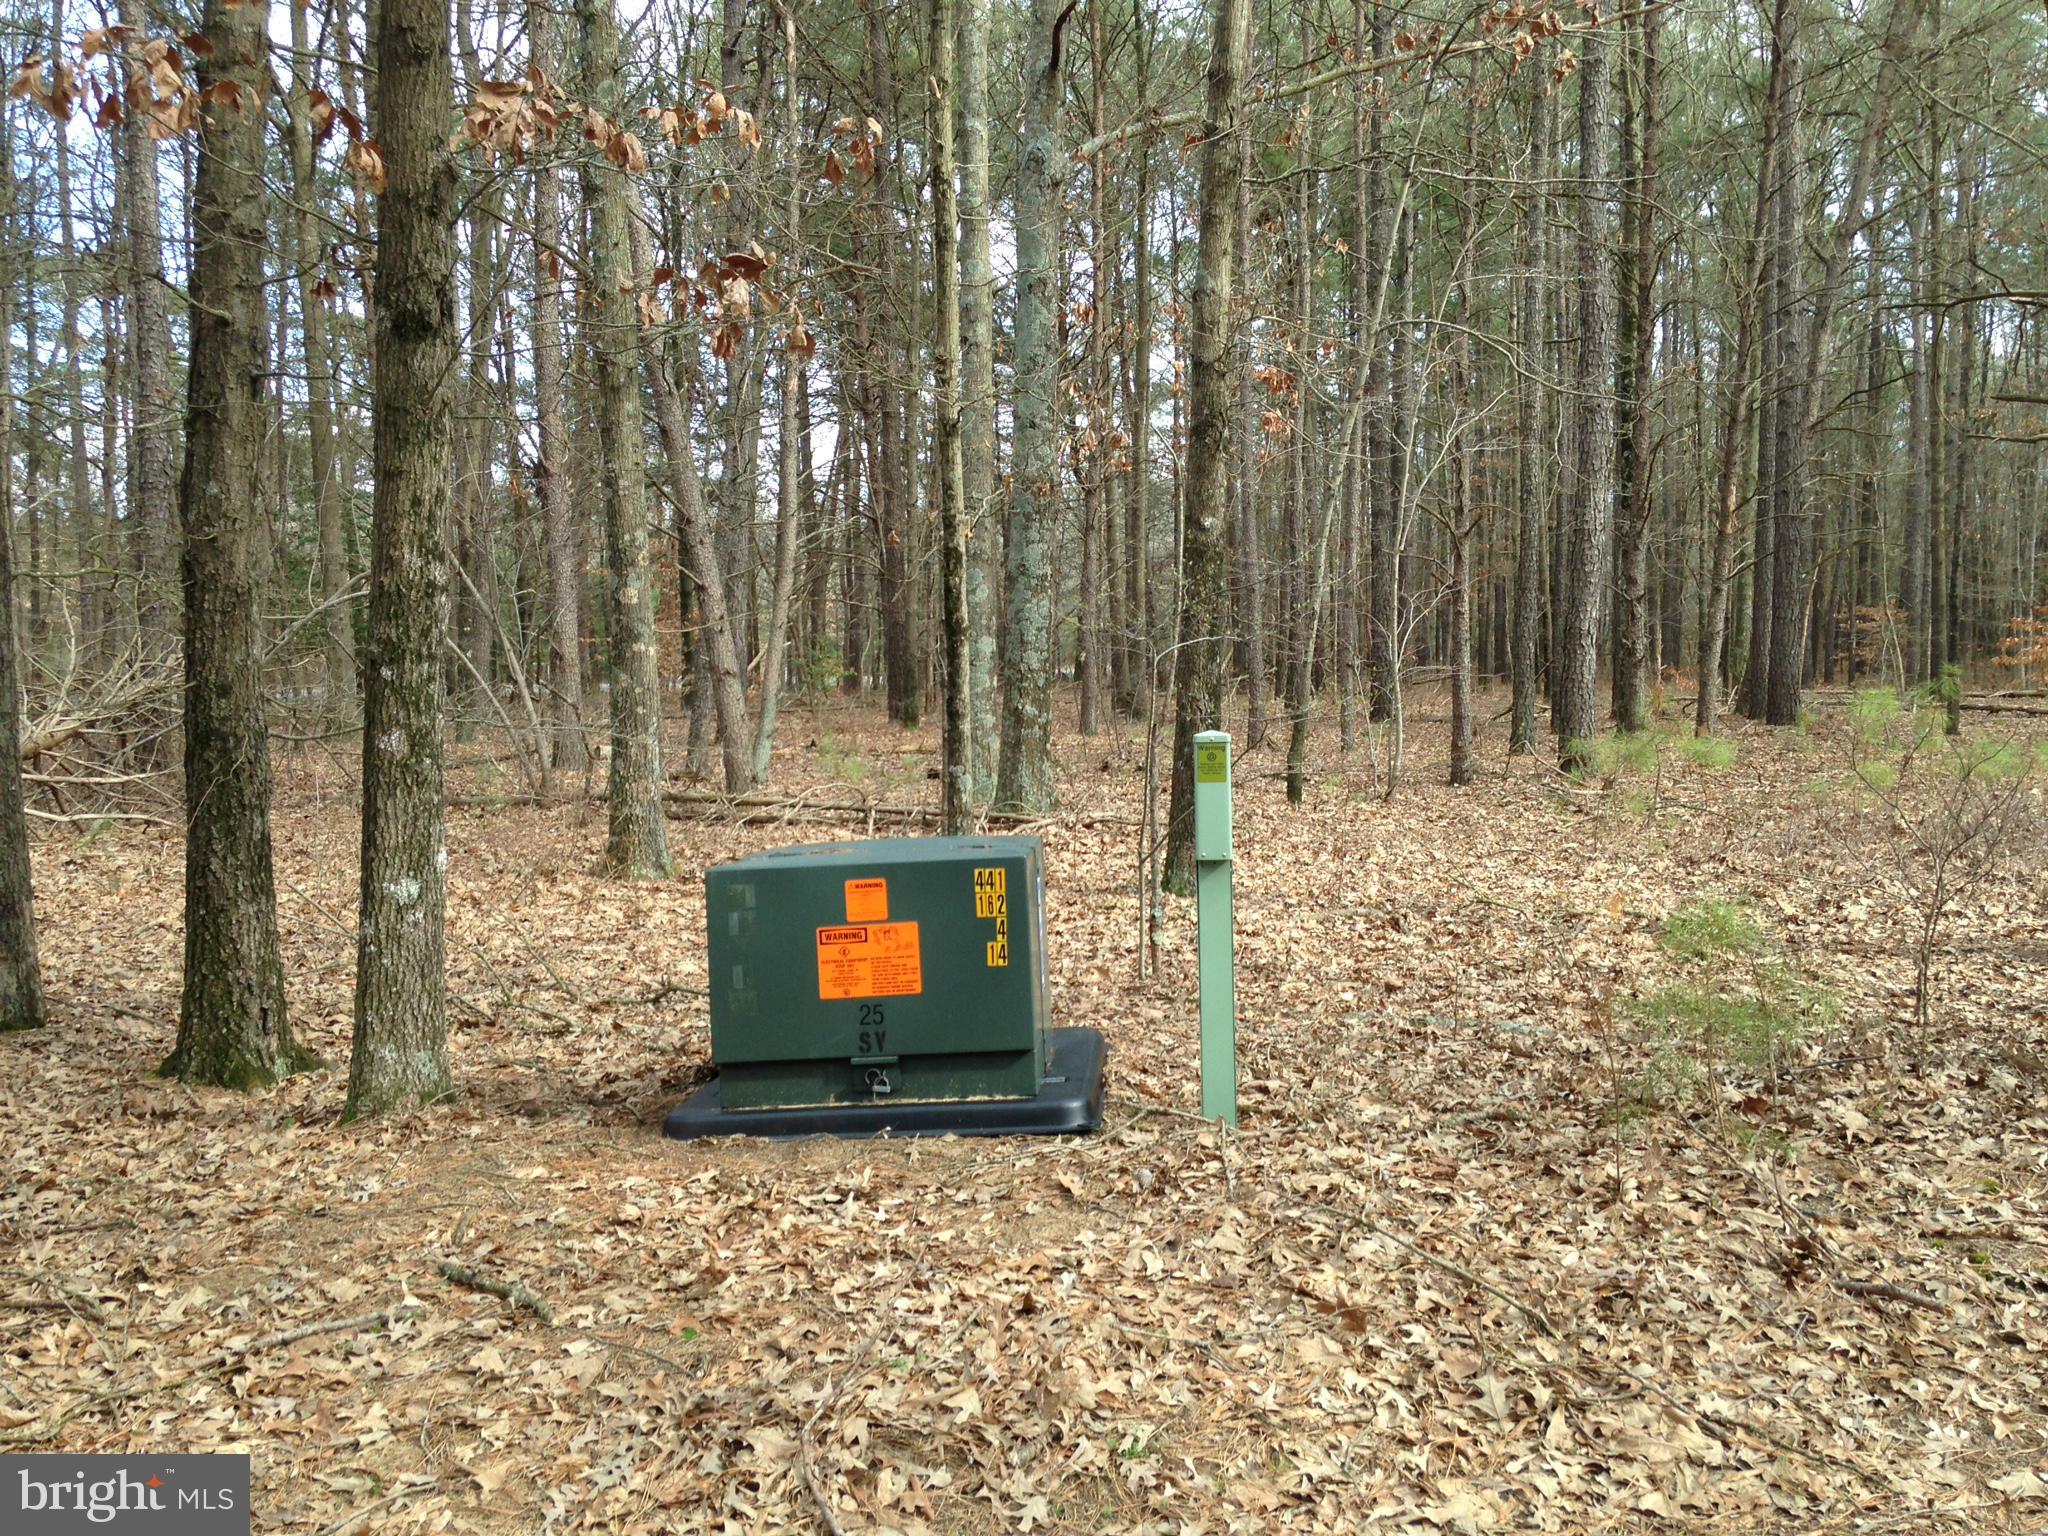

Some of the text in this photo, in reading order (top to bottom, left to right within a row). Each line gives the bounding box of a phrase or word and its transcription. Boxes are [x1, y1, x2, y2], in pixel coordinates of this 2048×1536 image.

[976, 870, 1002, 891] 441
[979, 894, 1005, 916] 162
[824, 931, 863, 941] WARNING
[997, 919, 1007, 940] 4
[990, 943, 1007, 964] 14
[859, 1003, 884, 1026] 25
